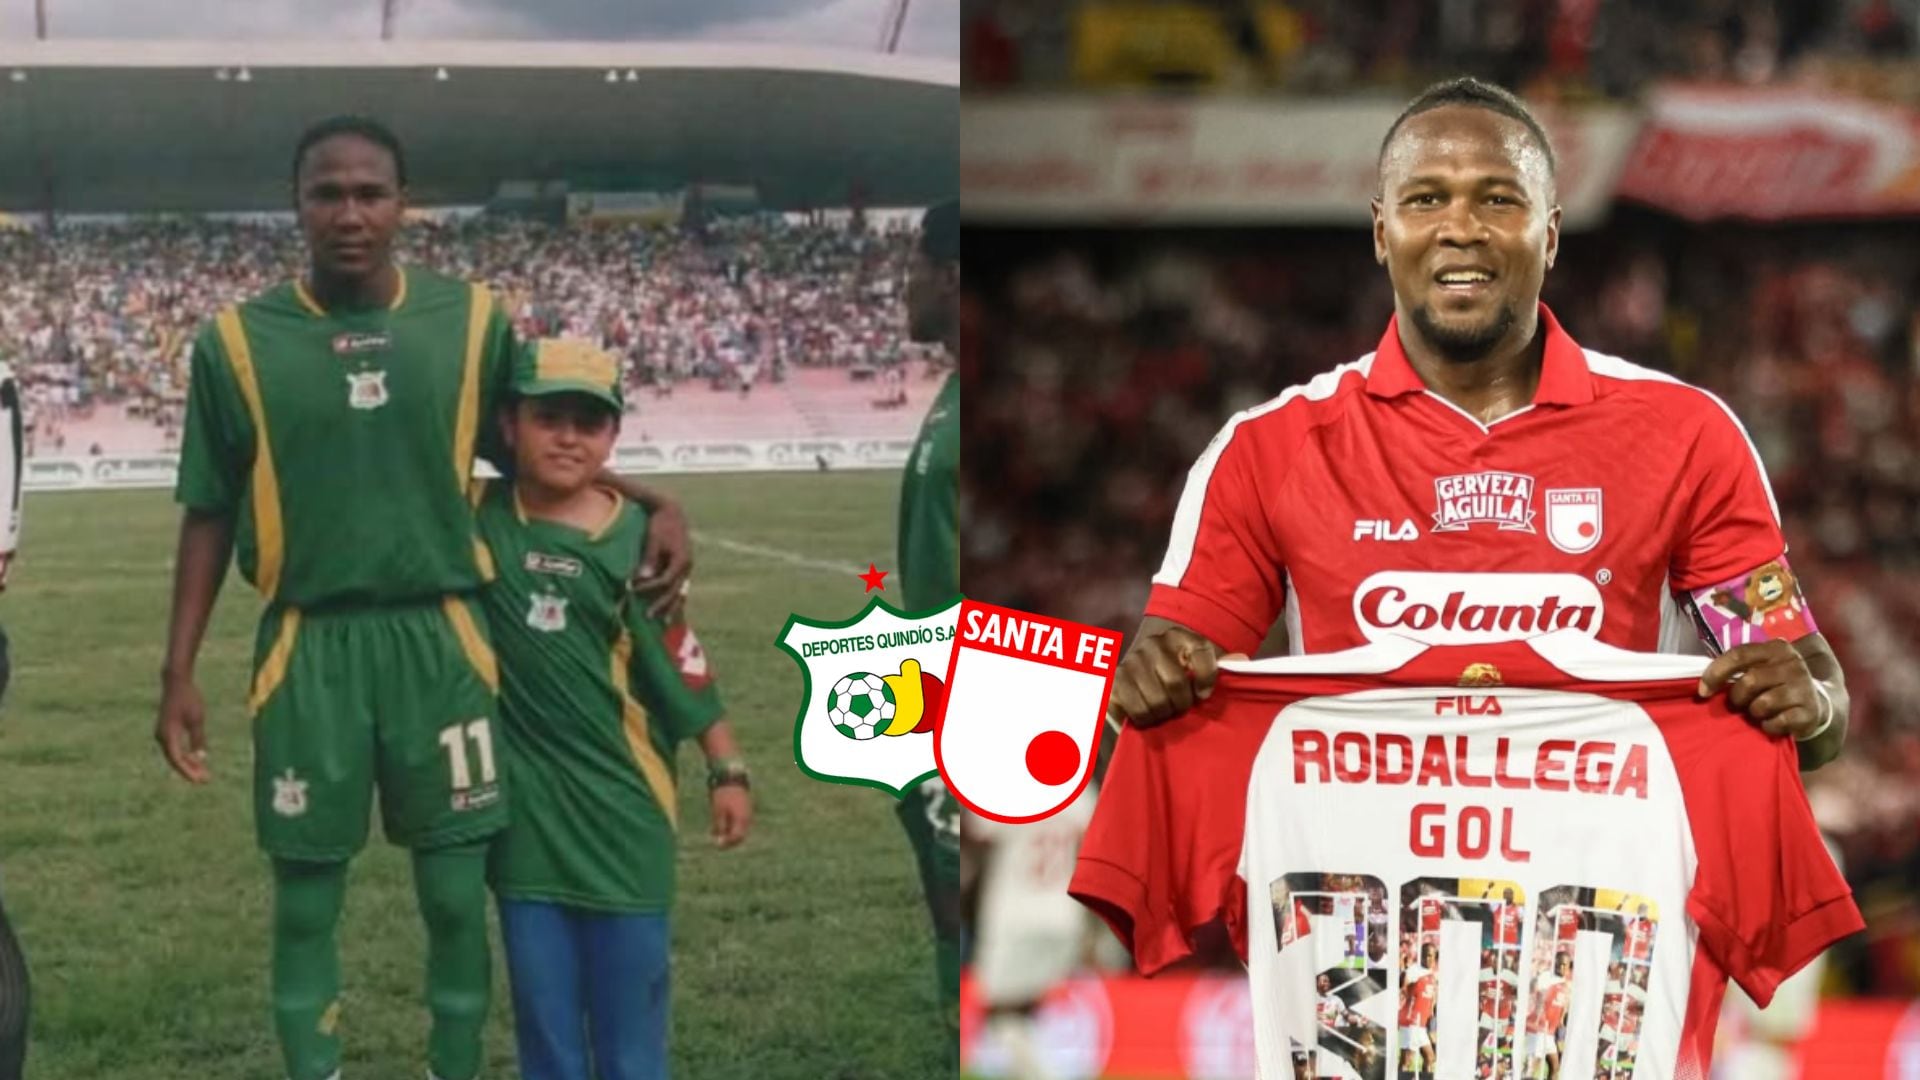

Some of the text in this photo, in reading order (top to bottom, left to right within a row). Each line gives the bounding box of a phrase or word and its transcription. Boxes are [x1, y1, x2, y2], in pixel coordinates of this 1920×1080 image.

[1443, 495, 1524, 523] AGUILA
[1551, 492, 1582, 504] SANTA
[1353, 518, 1420, 542] FILA
[1360, 585, 1596, 632] Colanta
[1435, 695, 1503, 716] FILA
[439, 717, 497, 790] 11
[1291, 729, 1649, 800] RODALLEGA
[1409, 803, 1531, 863] GOL
[1269, 871, 1660, 1080] 300
